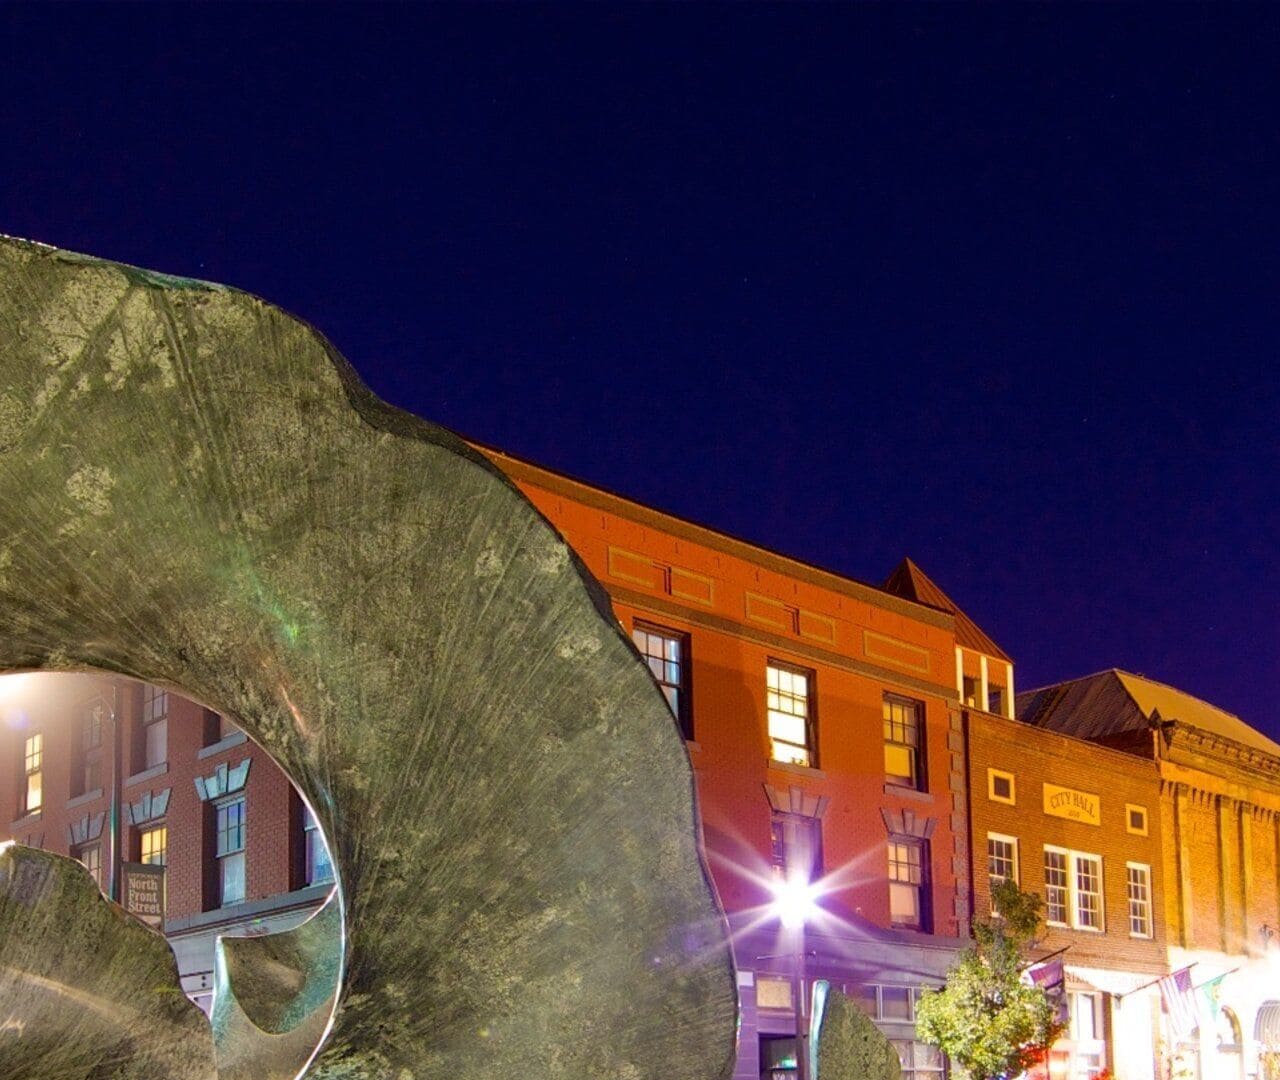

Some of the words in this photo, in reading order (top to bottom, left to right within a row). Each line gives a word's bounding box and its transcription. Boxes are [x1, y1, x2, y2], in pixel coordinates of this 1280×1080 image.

[1050, 791, 1071, 809] CITY
[1073, 792, 1096, 818] HALL
[128, 878, 158, 890] North
[128, 889, 158, 903] Front
[128, 901, 161, 914] Street
